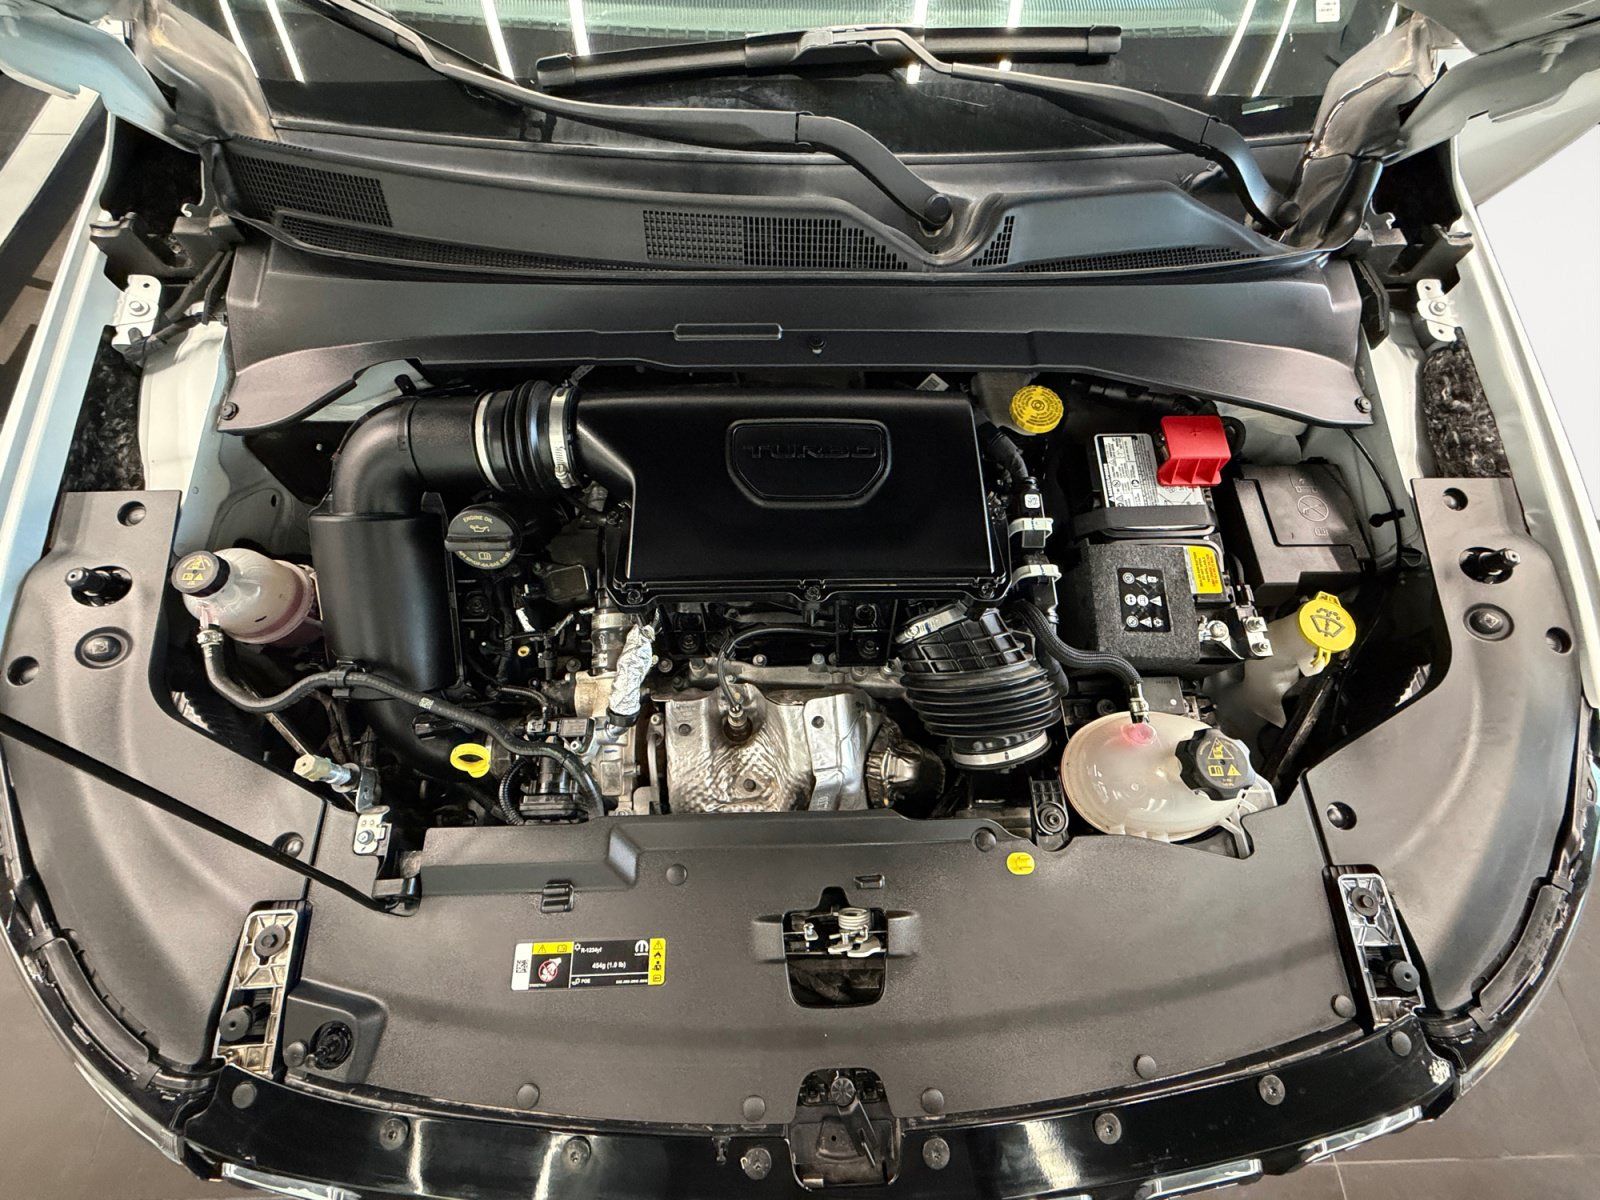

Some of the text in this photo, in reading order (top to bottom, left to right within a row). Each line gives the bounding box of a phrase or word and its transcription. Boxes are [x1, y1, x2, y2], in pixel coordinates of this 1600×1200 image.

[743, 445, 877, 459] TURBO
[580, 946, 602, 954] R-1234yf
[591, 962, 606, 970] 454g
